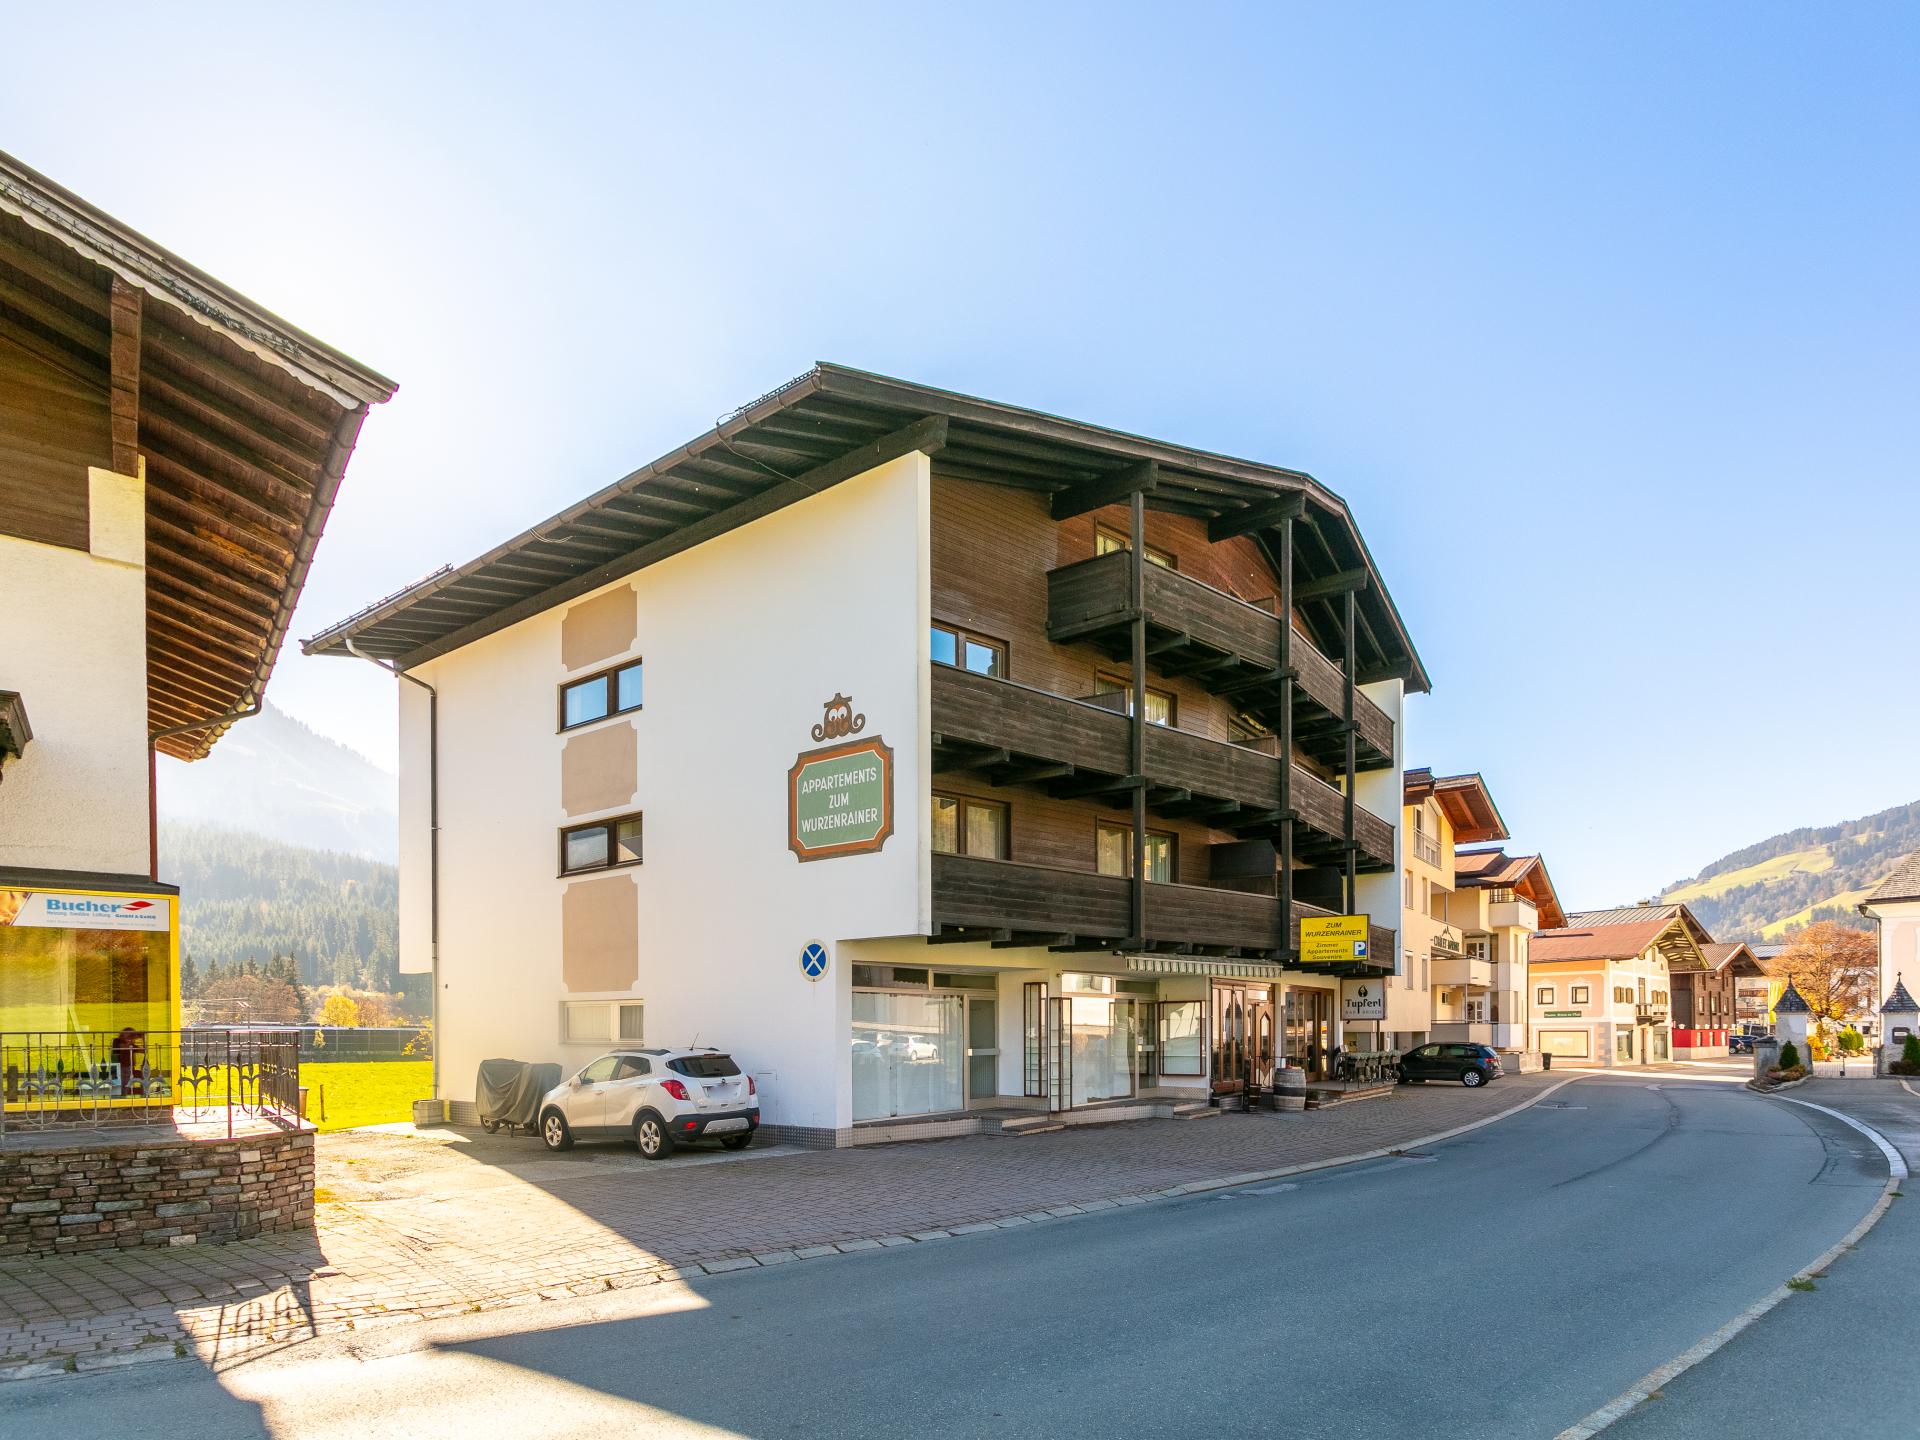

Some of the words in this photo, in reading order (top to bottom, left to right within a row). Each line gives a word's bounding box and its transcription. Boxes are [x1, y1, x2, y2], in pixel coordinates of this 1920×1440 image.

[802, 767, 877, 794] APPARTEMENTS
[829, 792, 849, 809] ZUM
[802, 808, 878, 833] WURZENRAINER
[47, 899, 121, 912] Bucher
[1305, 929, 1362, 938] WURZENRAINER
[1354, 941, 1366, 956] P
[1345, 998, 1381, 1014] Tupferl
